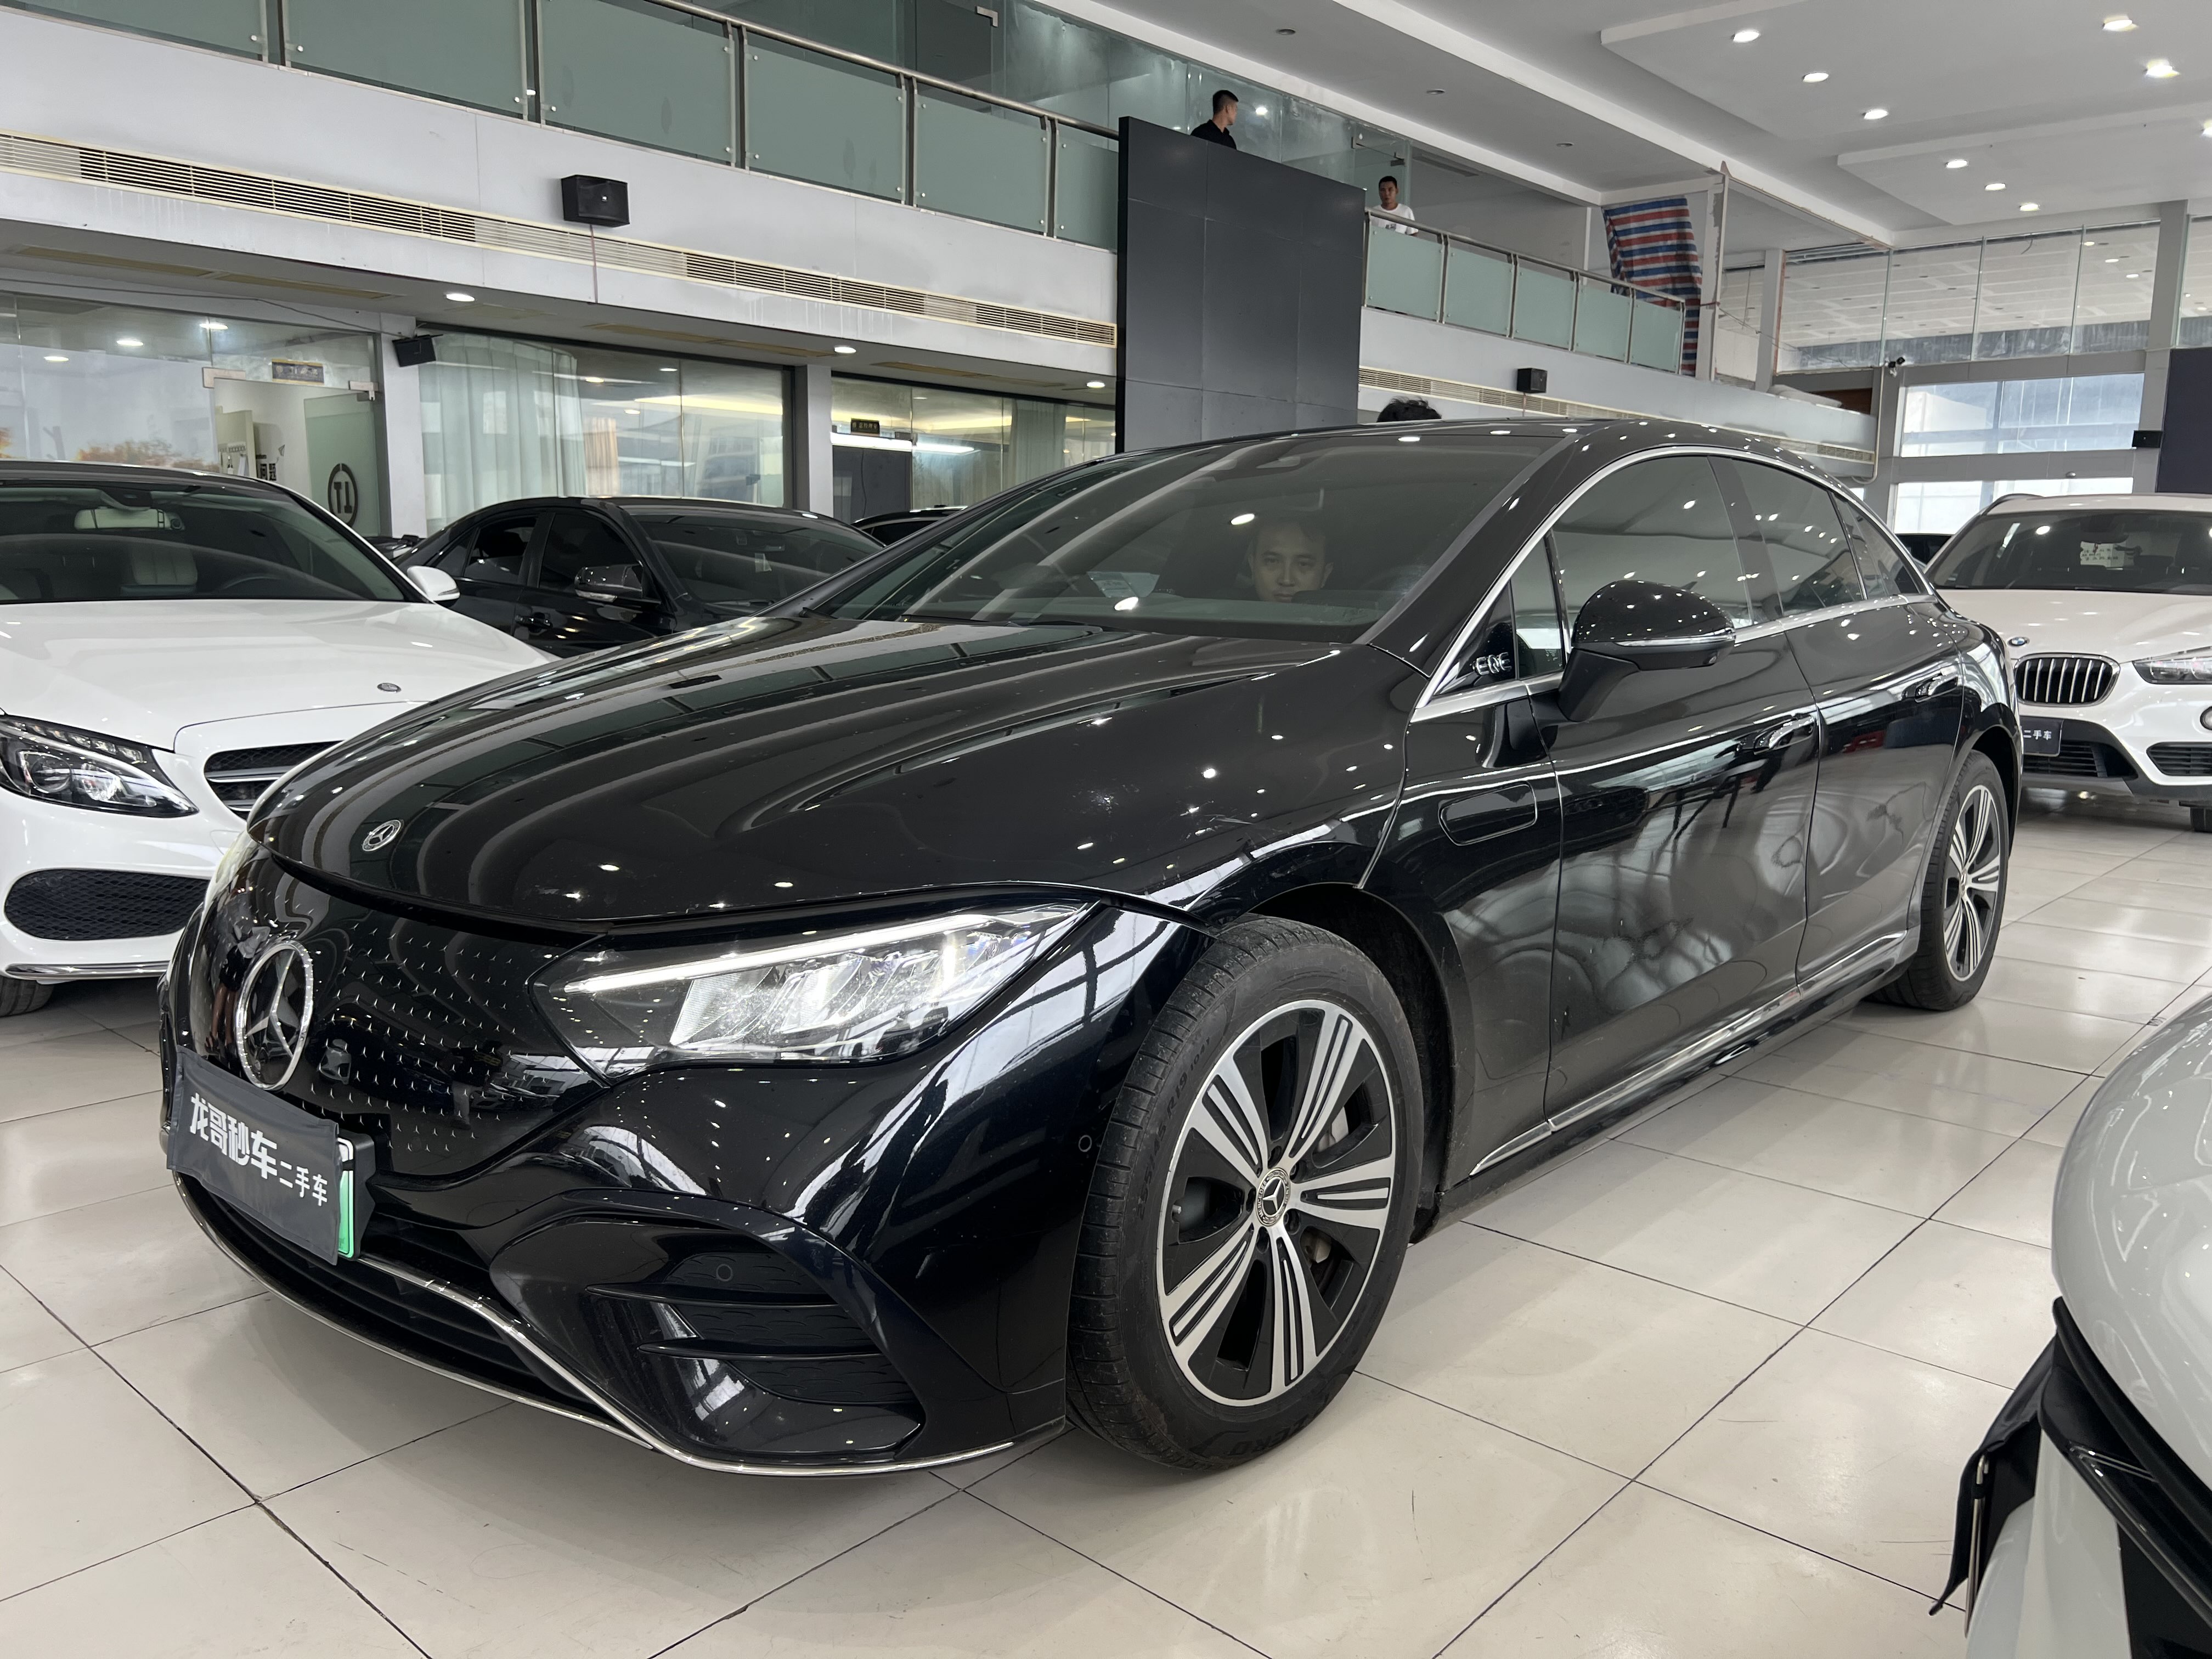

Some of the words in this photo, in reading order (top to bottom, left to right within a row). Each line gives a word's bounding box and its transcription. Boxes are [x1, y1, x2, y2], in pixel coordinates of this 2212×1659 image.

[1476, 652, 1512, 676] EQE
[2023, 730, 2052, 740] 二手车
[1167, 1071, 1188, 1120] R19
[190, 1092, 277, 1180] 龙哥秒车
[279, 1161, 328, 1206] 二手车
[1257, 1180, 1267, 1218] MERCEDES
